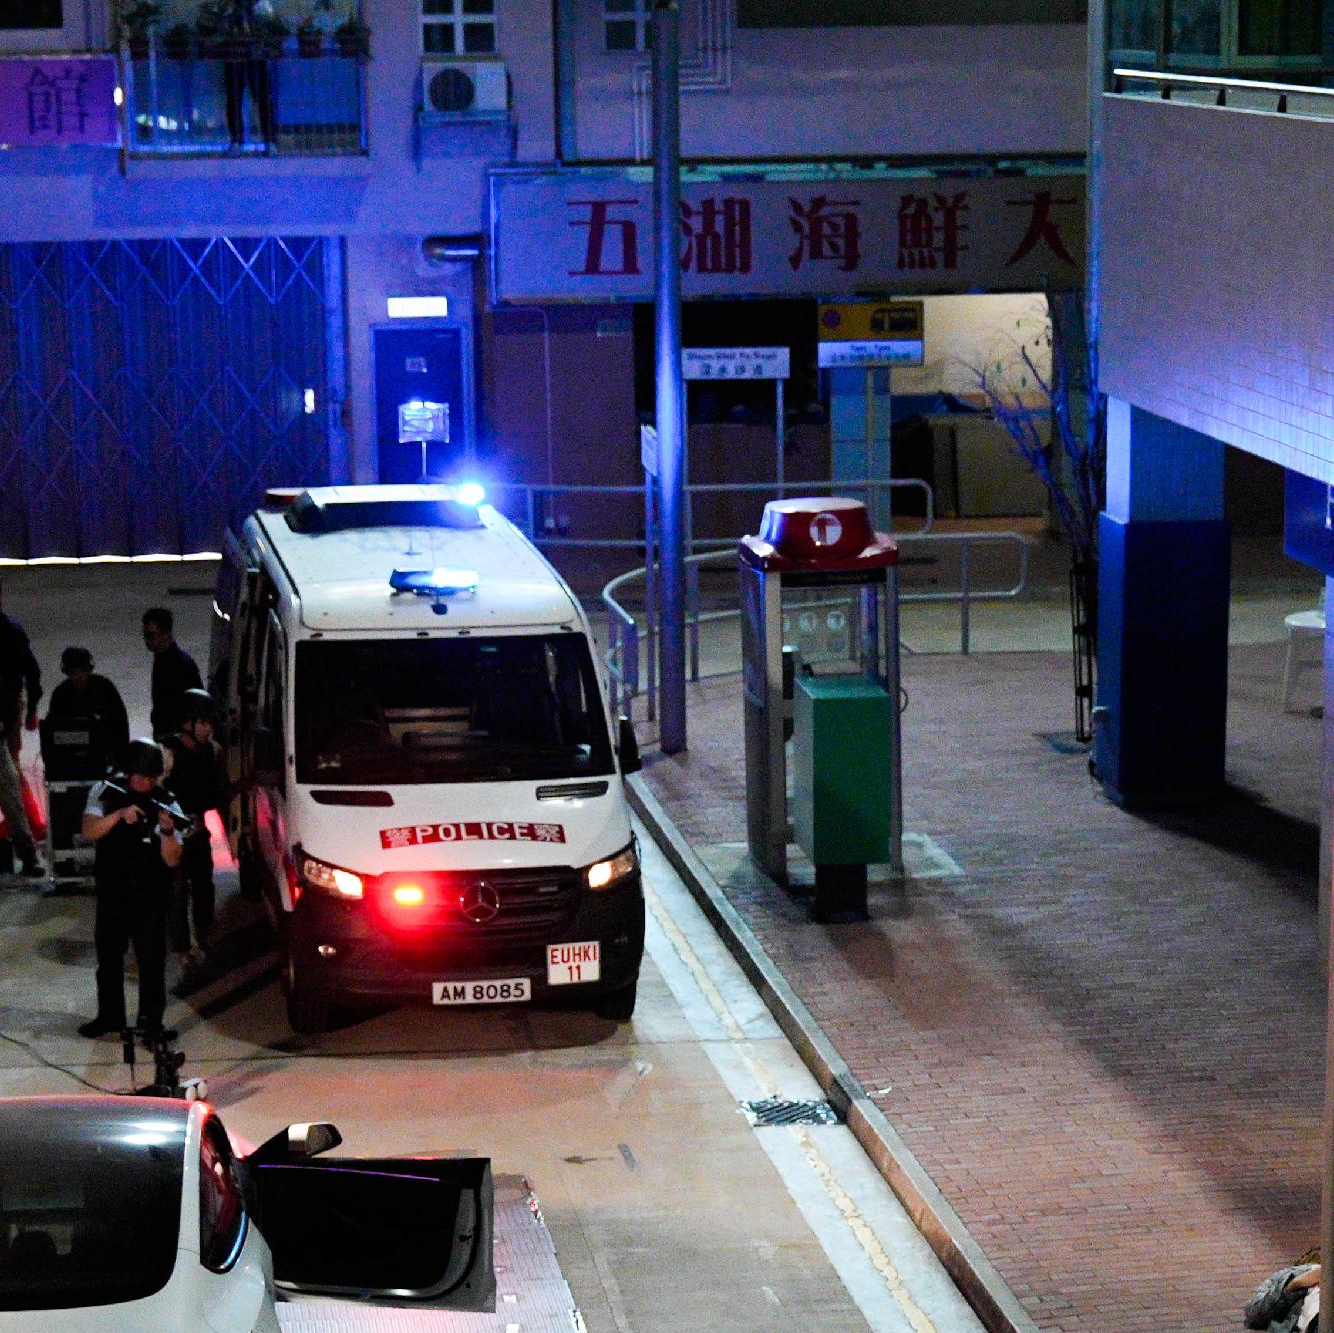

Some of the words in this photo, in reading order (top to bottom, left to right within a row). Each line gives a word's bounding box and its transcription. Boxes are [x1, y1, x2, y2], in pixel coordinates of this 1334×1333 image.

[567, 191, 1076, 275] 五湖海鮮大
[417, 822, 532, 844] POLICE
[568, 965, 582, 982] 11
[440, 985, 466, 1001] AM
[473, 983, 525, 1000] 8085
